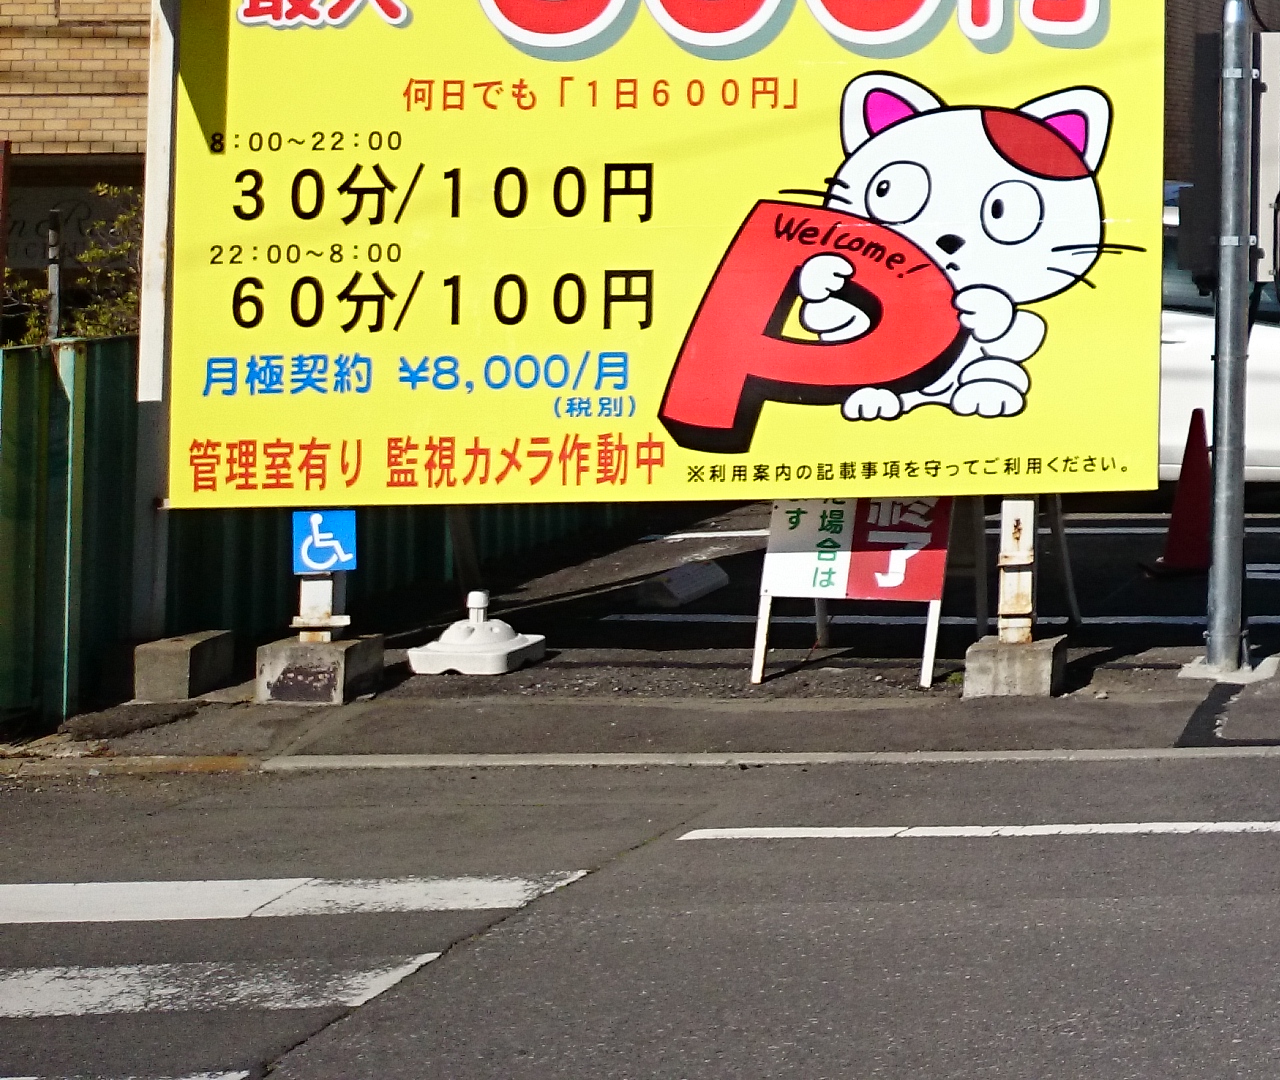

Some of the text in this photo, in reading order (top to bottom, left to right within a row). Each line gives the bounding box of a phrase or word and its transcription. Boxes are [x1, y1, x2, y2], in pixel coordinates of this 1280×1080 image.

[403, 78, 801, 113] 何日でも「1日600円」
[233, 160, 655, 226] 30分/100円
[775, 211, 926, 282] Welcome!
[231, 267, 655, 332] 60分/100円
[202, 351, 631, 396] 月極契約 ¥8,000/月
[189, 433, 666, 493] 管理室有り 監視カメラ作動中
[811, 499, 846, 589] 場合は
